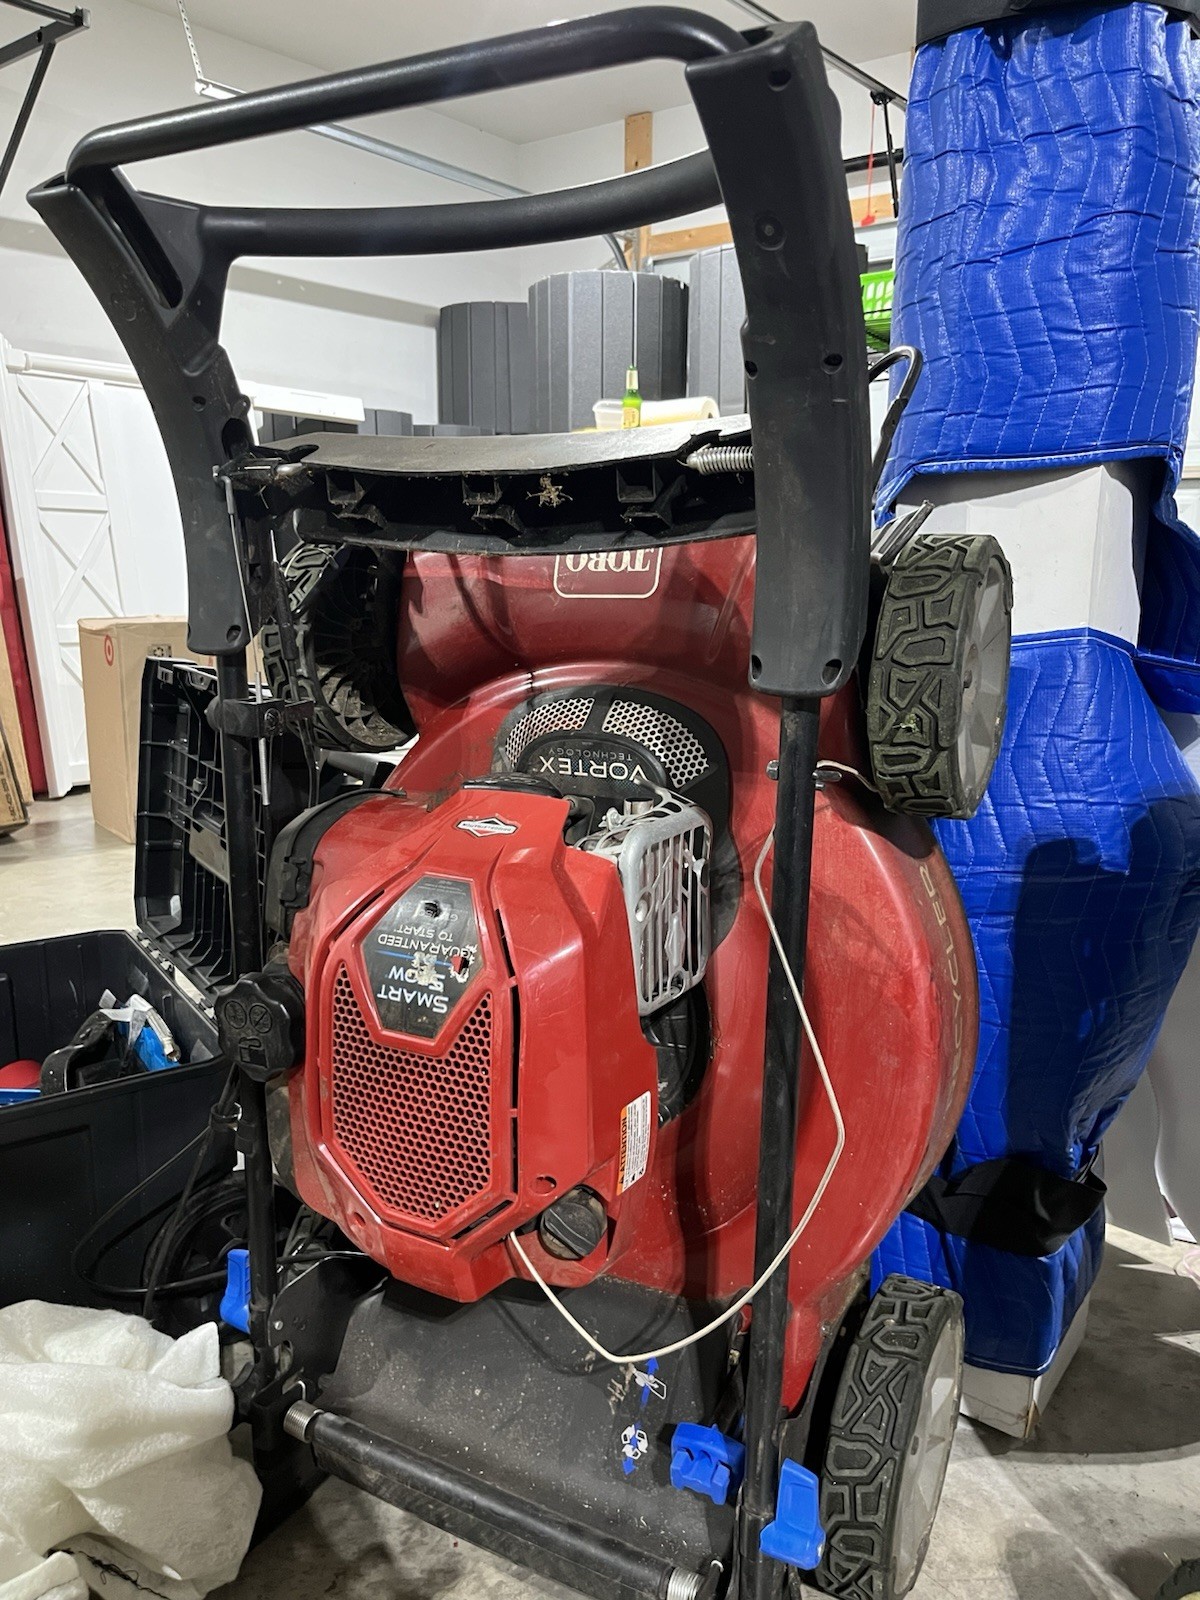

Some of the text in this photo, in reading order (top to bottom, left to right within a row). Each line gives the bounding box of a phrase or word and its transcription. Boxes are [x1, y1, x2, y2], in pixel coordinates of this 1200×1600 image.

[565, 547, 651, 573] TORO
[549, 747, 633, 762] TECHNOLOGY
[539, 755, 648, 781] VORTEX
[377, 933, 472, 960] GUARANTEED
[437, 931, 454, 943] TO
[376, 983, 450, 1014] SMART
